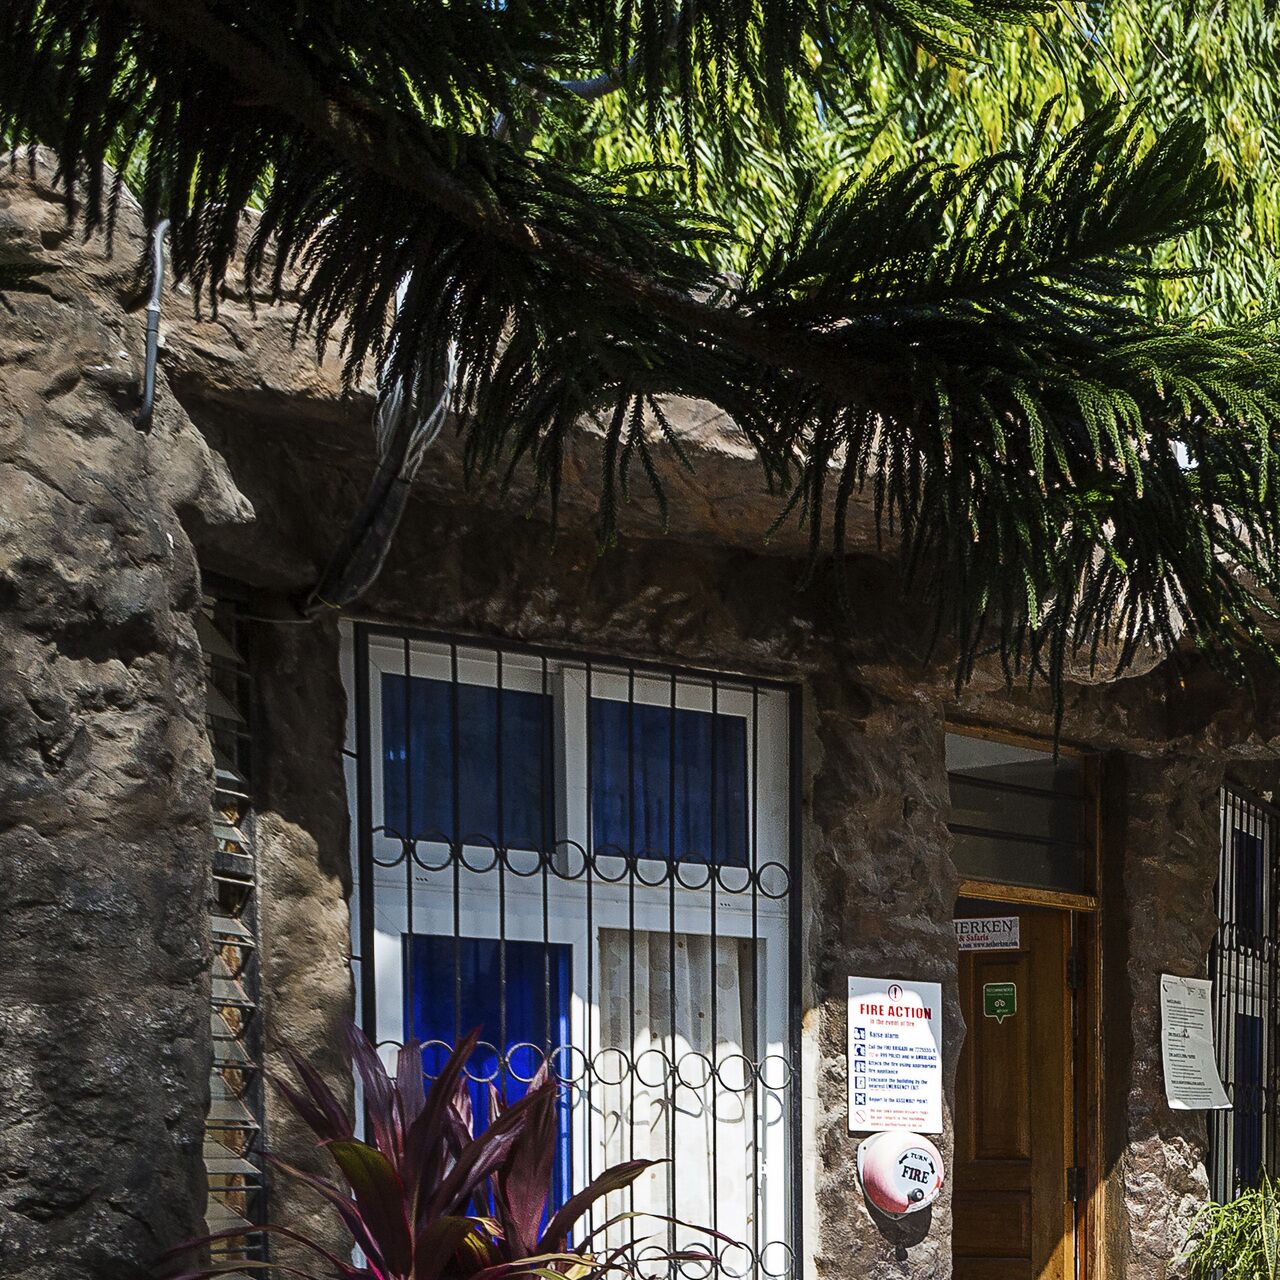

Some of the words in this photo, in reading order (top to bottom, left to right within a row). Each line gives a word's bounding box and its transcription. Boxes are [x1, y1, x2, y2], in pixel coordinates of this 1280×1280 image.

[860, 1003, 885, 1017] FIRE
[888, 1005, 932, 1020] ACTION
[911, 1152, 929, 1162] TURN
[901, 1165, 930, 1184] FIRE
